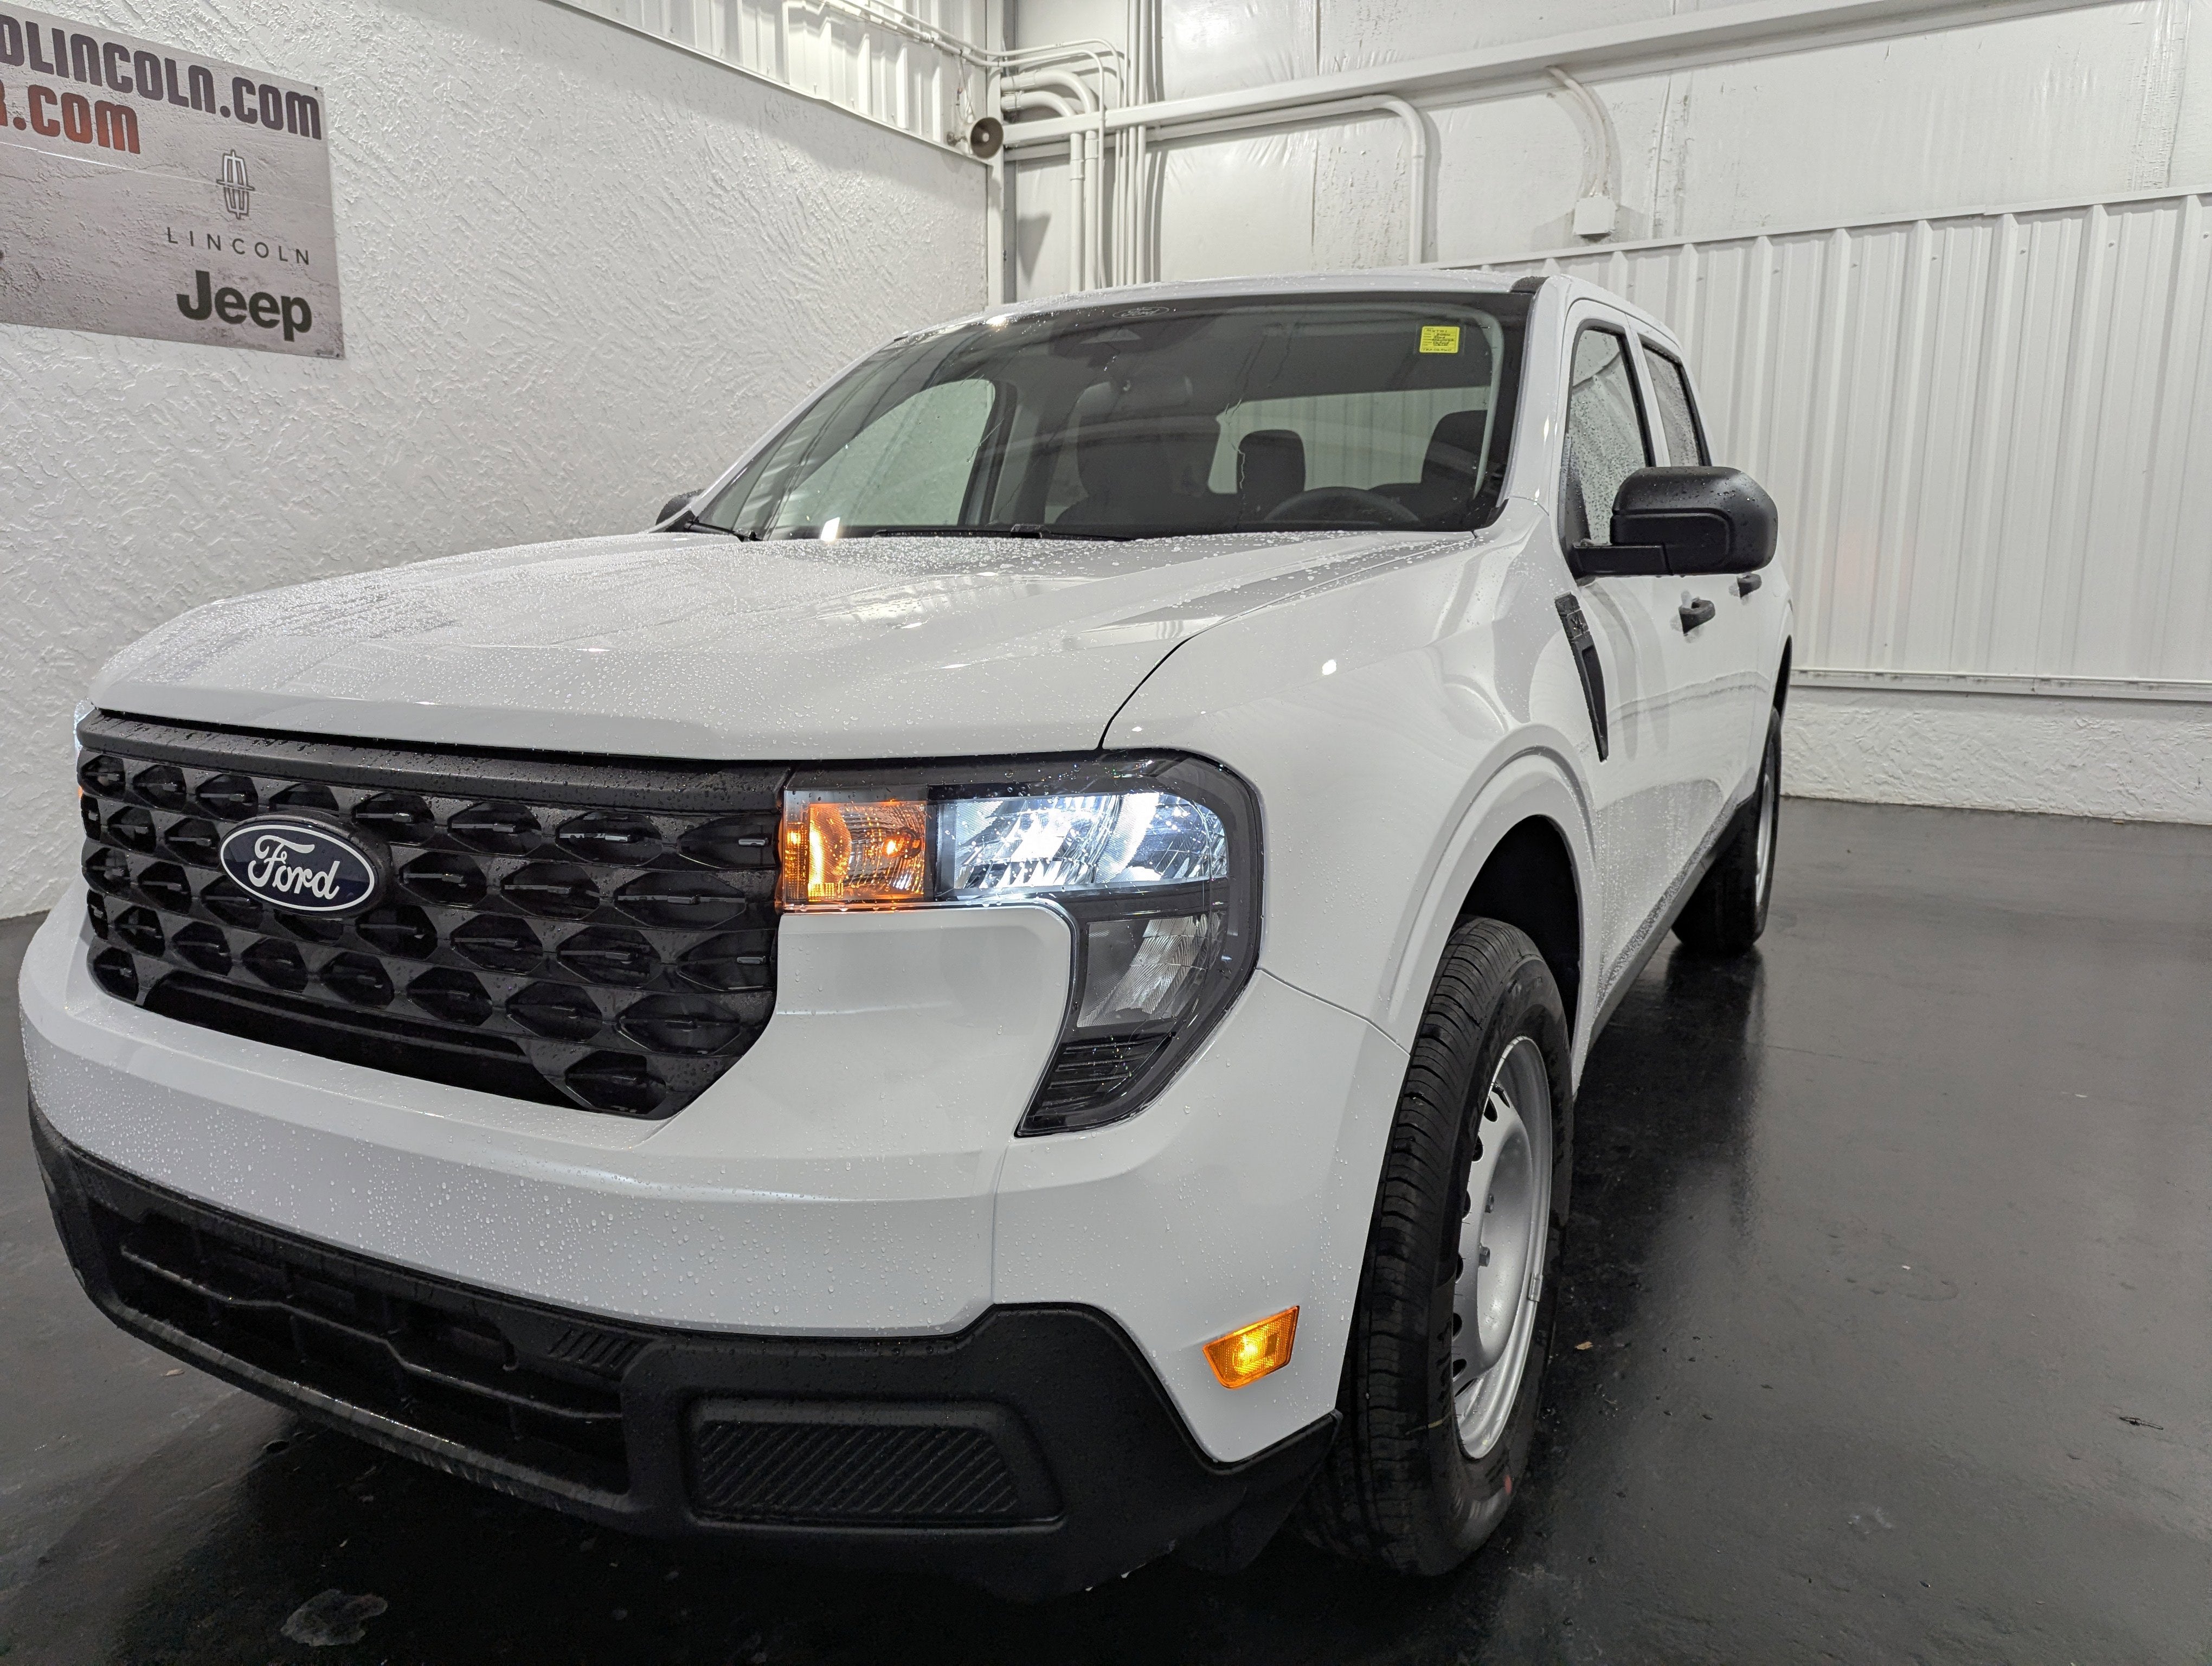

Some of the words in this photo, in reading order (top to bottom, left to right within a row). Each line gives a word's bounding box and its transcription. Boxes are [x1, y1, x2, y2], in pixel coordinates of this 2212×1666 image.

[167, 227, 309, 265] LINCOLN
[176, 270, 312, 342] Jeep
[248, 835, 340, 899] Ford
